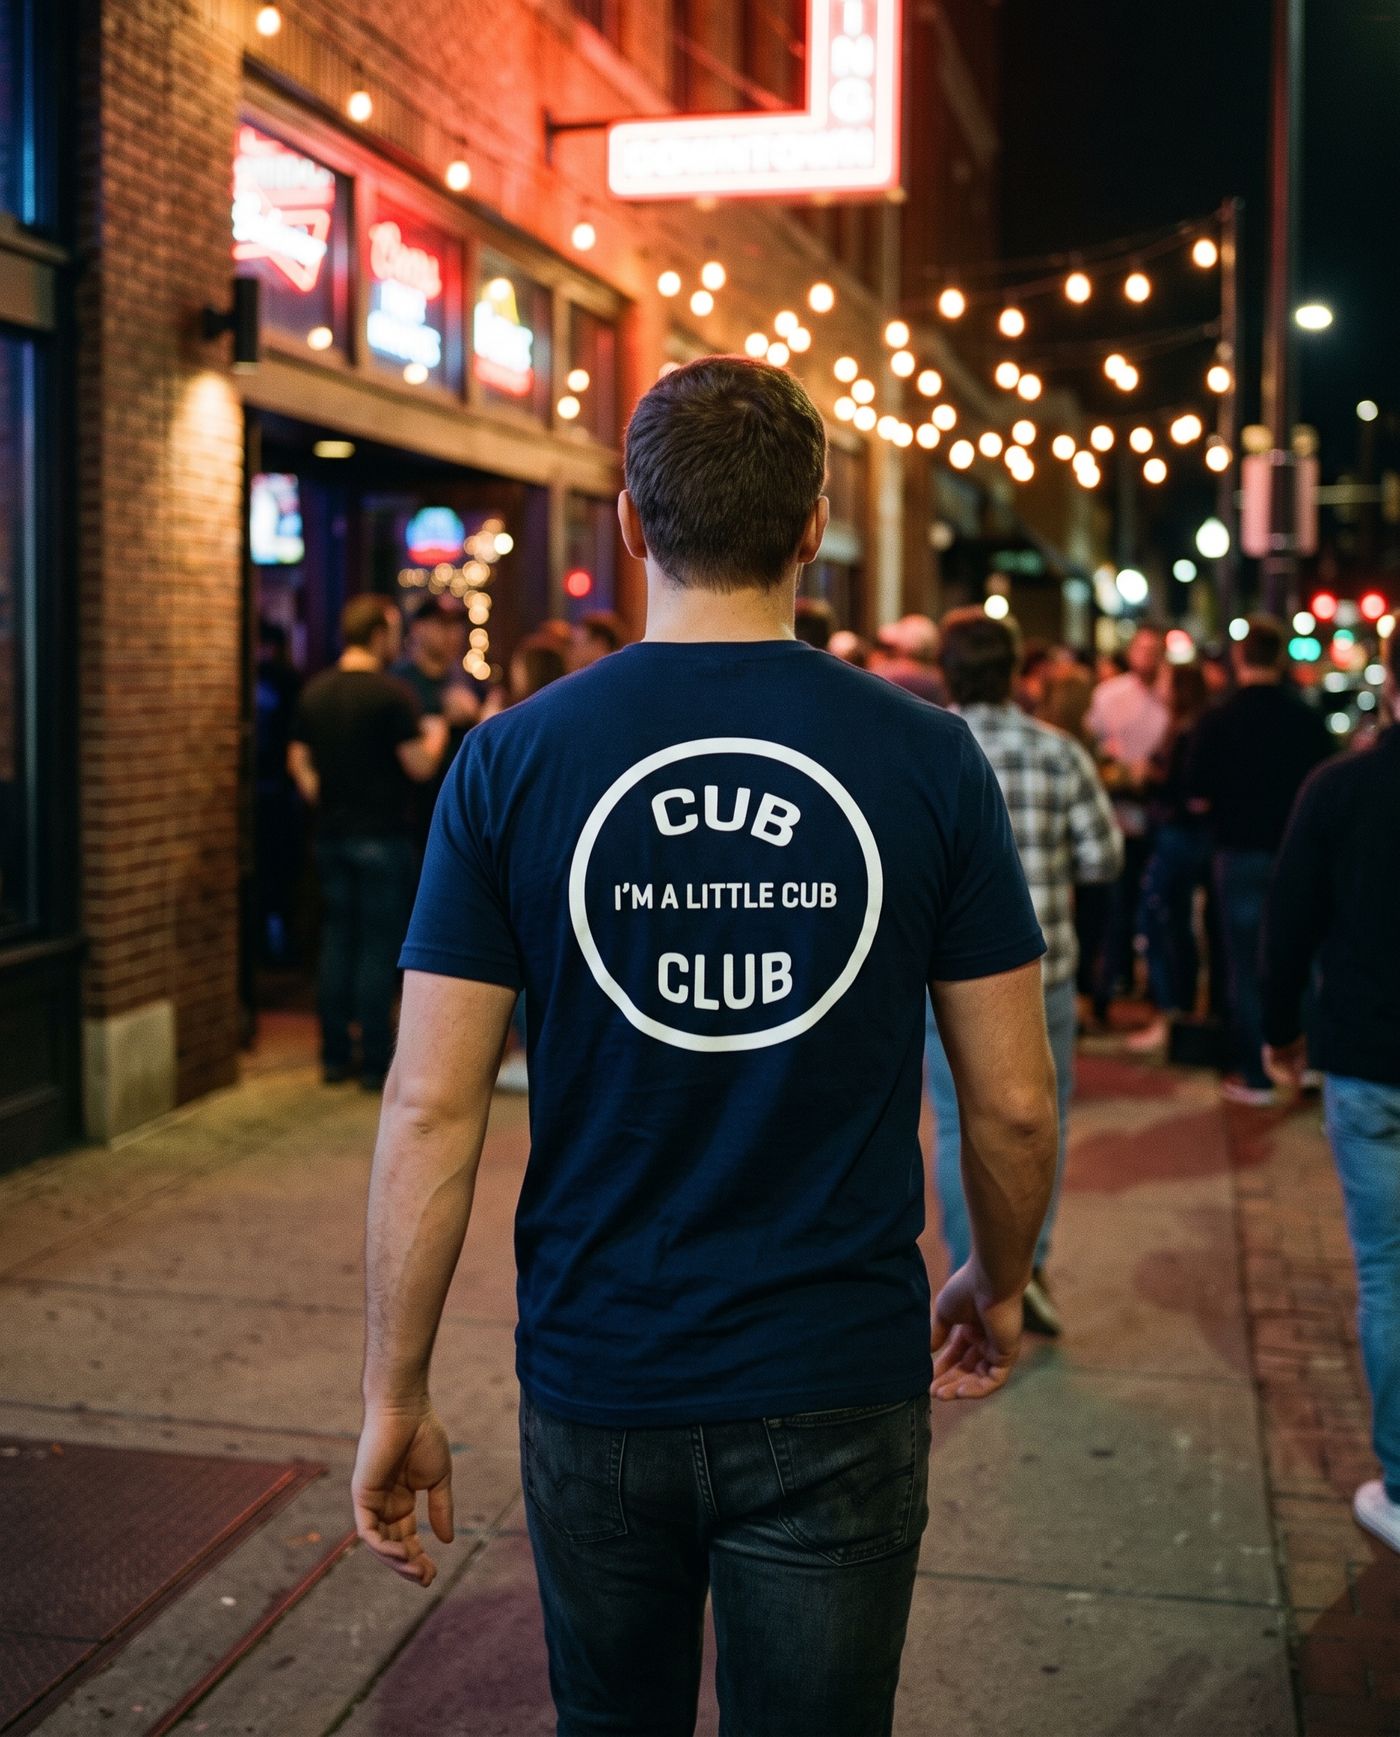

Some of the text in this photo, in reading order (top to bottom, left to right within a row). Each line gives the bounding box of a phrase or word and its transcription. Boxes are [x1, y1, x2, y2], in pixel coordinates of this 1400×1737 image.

[651, 785, 801, 847] CUB
[614, 882, 837, 911] I'M A LITTLE CUB
[657, 951, 793, 1011] CLUB
